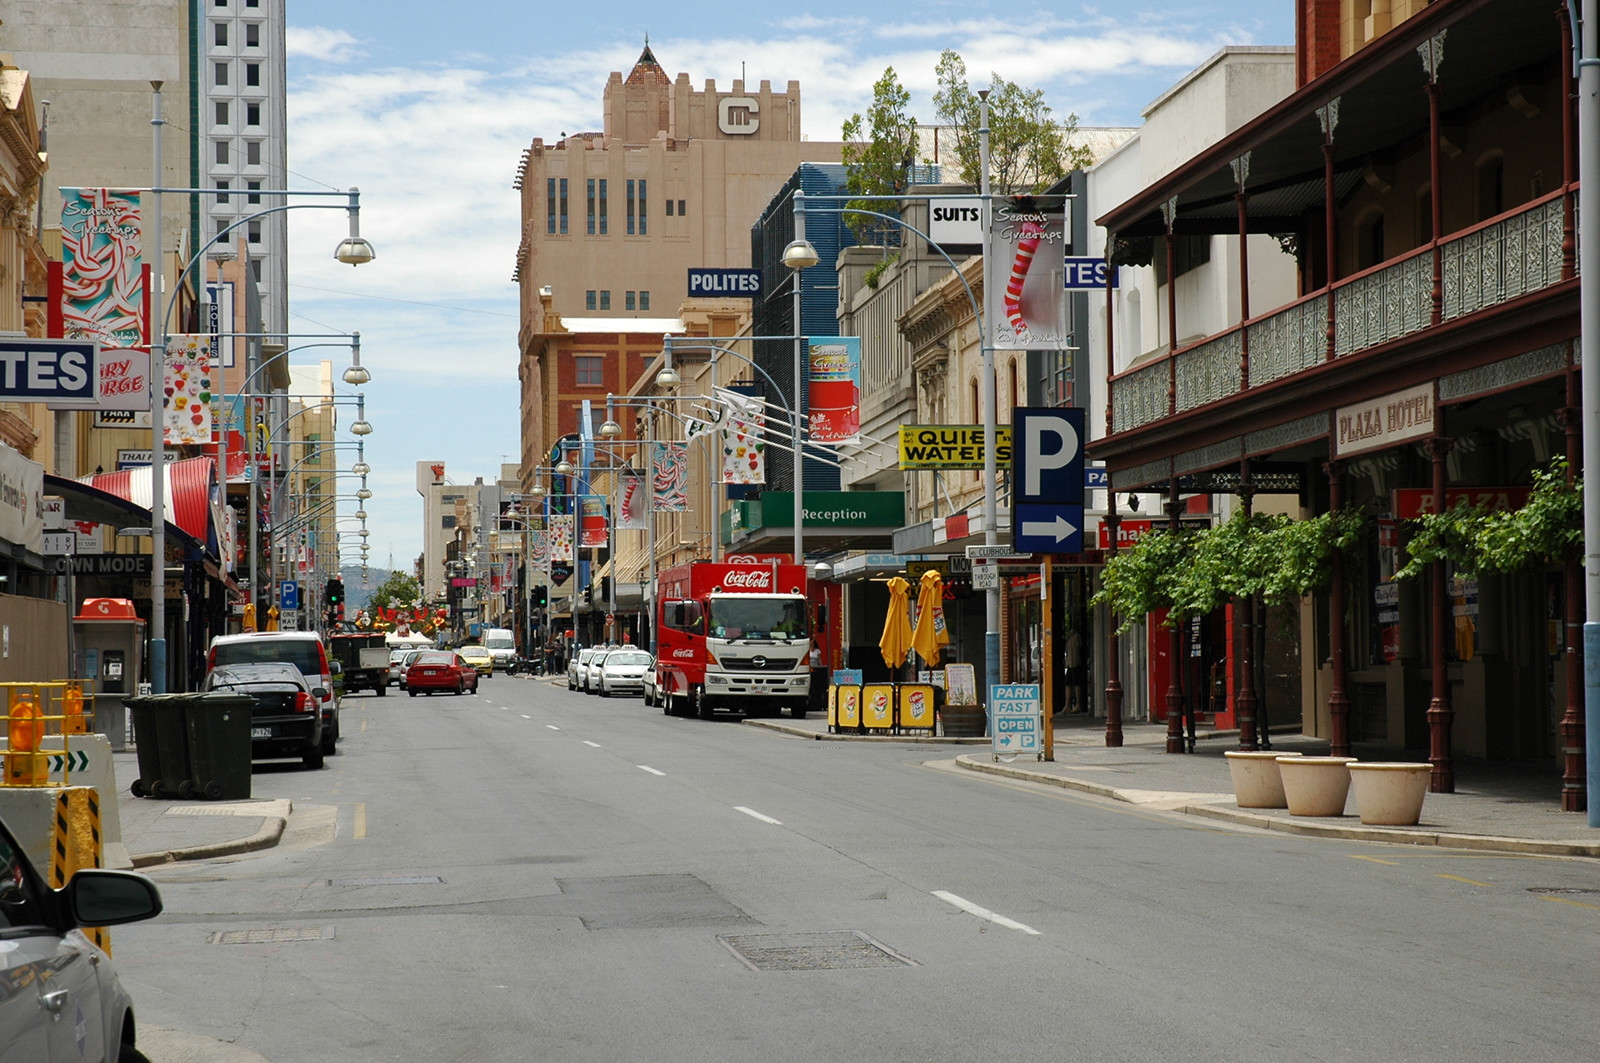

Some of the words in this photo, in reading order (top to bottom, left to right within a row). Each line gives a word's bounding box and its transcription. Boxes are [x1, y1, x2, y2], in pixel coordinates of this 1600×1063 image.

[933, 207, 980, 222] SUITS
[994, 207, 1049, 223] Season's
[999, 225, 1063, 245] Greetings
[690, 274, 760, 291] POLITES
[1338, 407, 1383, 445] PLAZA
[1386, 393, 1432, 434] HOTEL
[122, 453, 145, 461] THAI
[1025, 415, 1078, 496] P
[801, 509, 867, 522] Reception
[100, 557, 146, 573] MODE
[283, 583, 295, 598] P
[979, 580, 992, 588] ROAD
[282, 620, 296, 628] WAY
[995, 687, 1034, 699] PARK
[998, 702, 1033, 714] FAST
[999, 719, 1034, 731] OPEN
[1022, 736, 1033, 746] P
